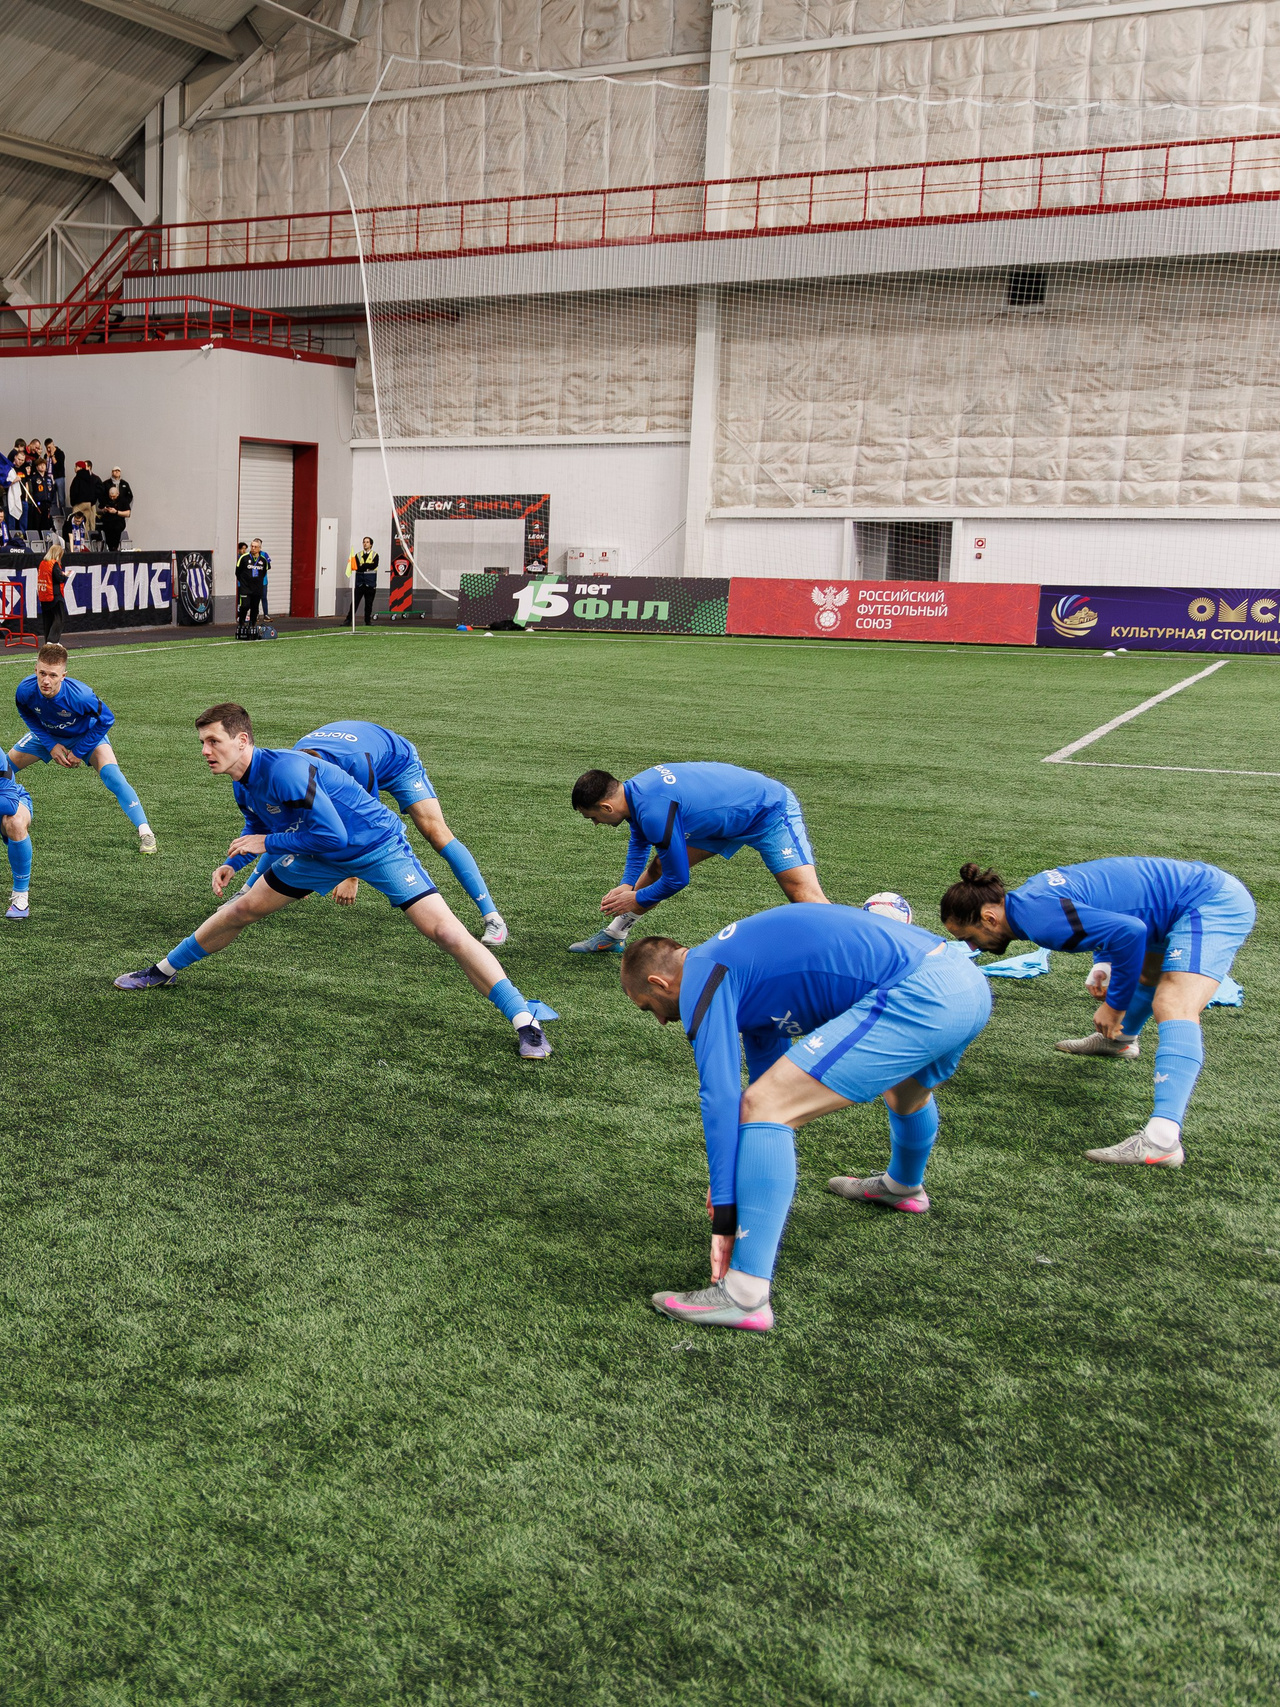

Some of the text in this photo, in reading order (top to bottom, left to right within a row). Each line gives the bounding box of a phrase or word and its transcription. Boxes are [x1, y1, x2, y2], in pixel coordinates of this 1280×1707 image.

[420, 501, 452, 510] LEON
[512, 583, 569, 621] 15
[858, 589, 945, 603] РОССИЙСКИЙ
[573, 597, 669, 620] ФНЛ
[856, 603, 948, 617] ФУТБОЛЬНЫЙ
[1188, 597, 1280, 624] ОМС
[855, 617, 892, 629] СОЮЗ
[1110, 626, 1280, 644] КУЛЬТУРНАЯ СТОЛИЦ
